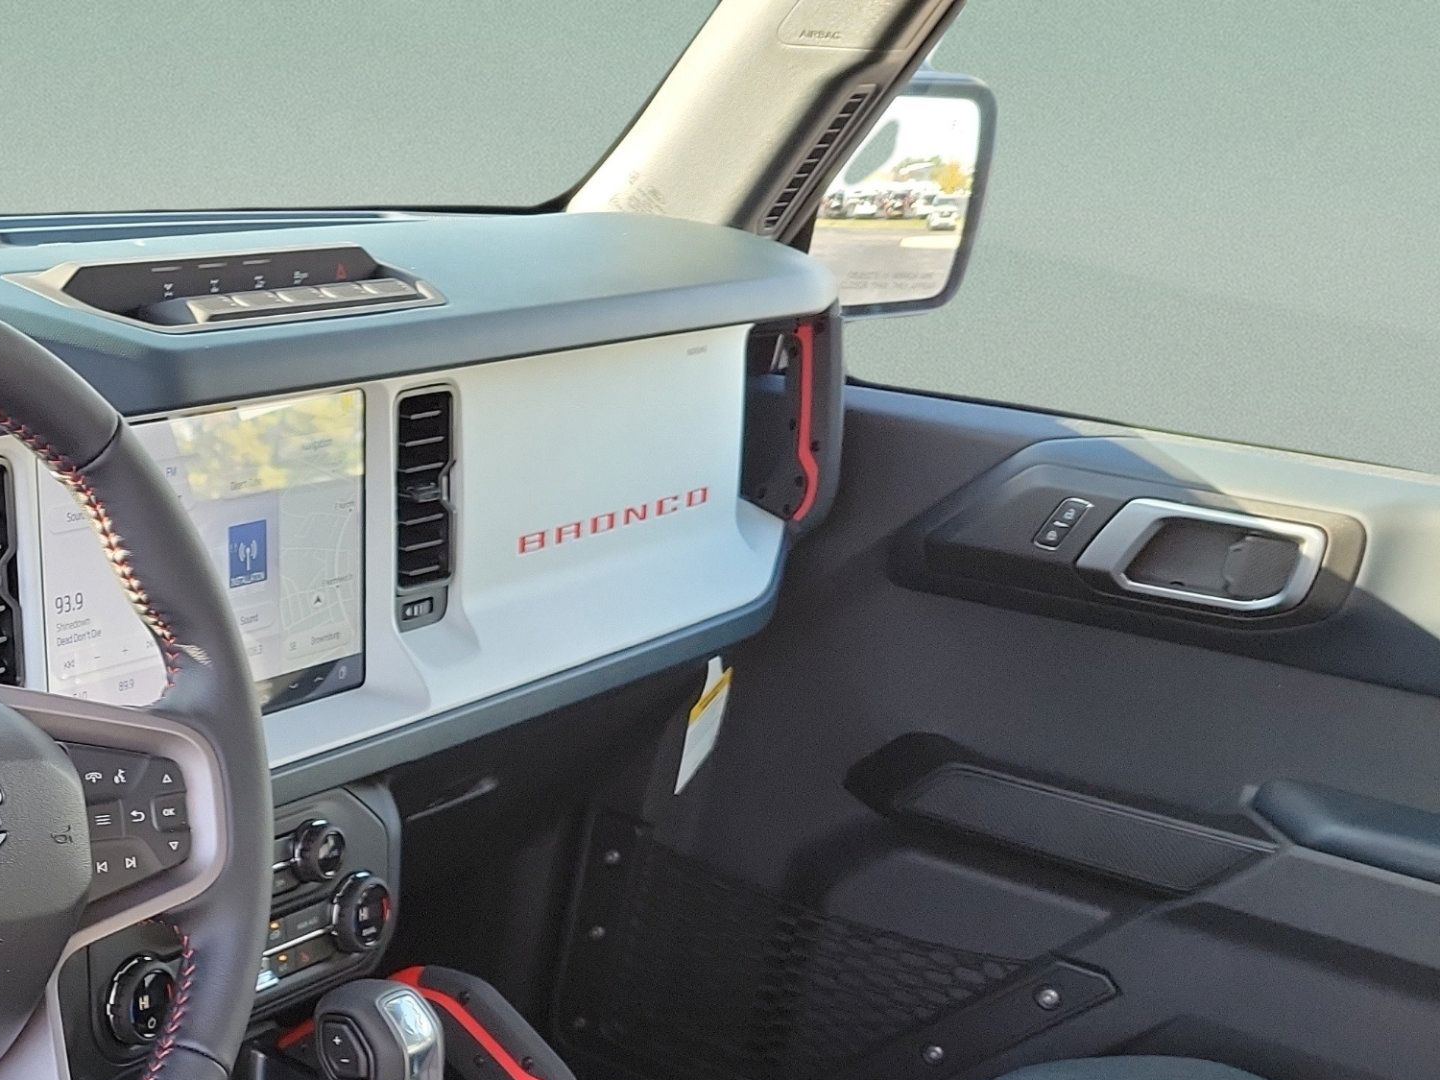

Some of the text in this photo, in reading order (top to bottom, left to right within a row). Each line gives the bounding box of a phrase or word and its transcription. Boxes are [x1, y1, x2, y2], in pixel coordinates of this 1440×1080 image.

[166, 466, 177, 477] FM
[518, 486, 709, 555] BRONCO
[55, 592, 83, 614] 93.9
[162, 807, 176, 817] OK
